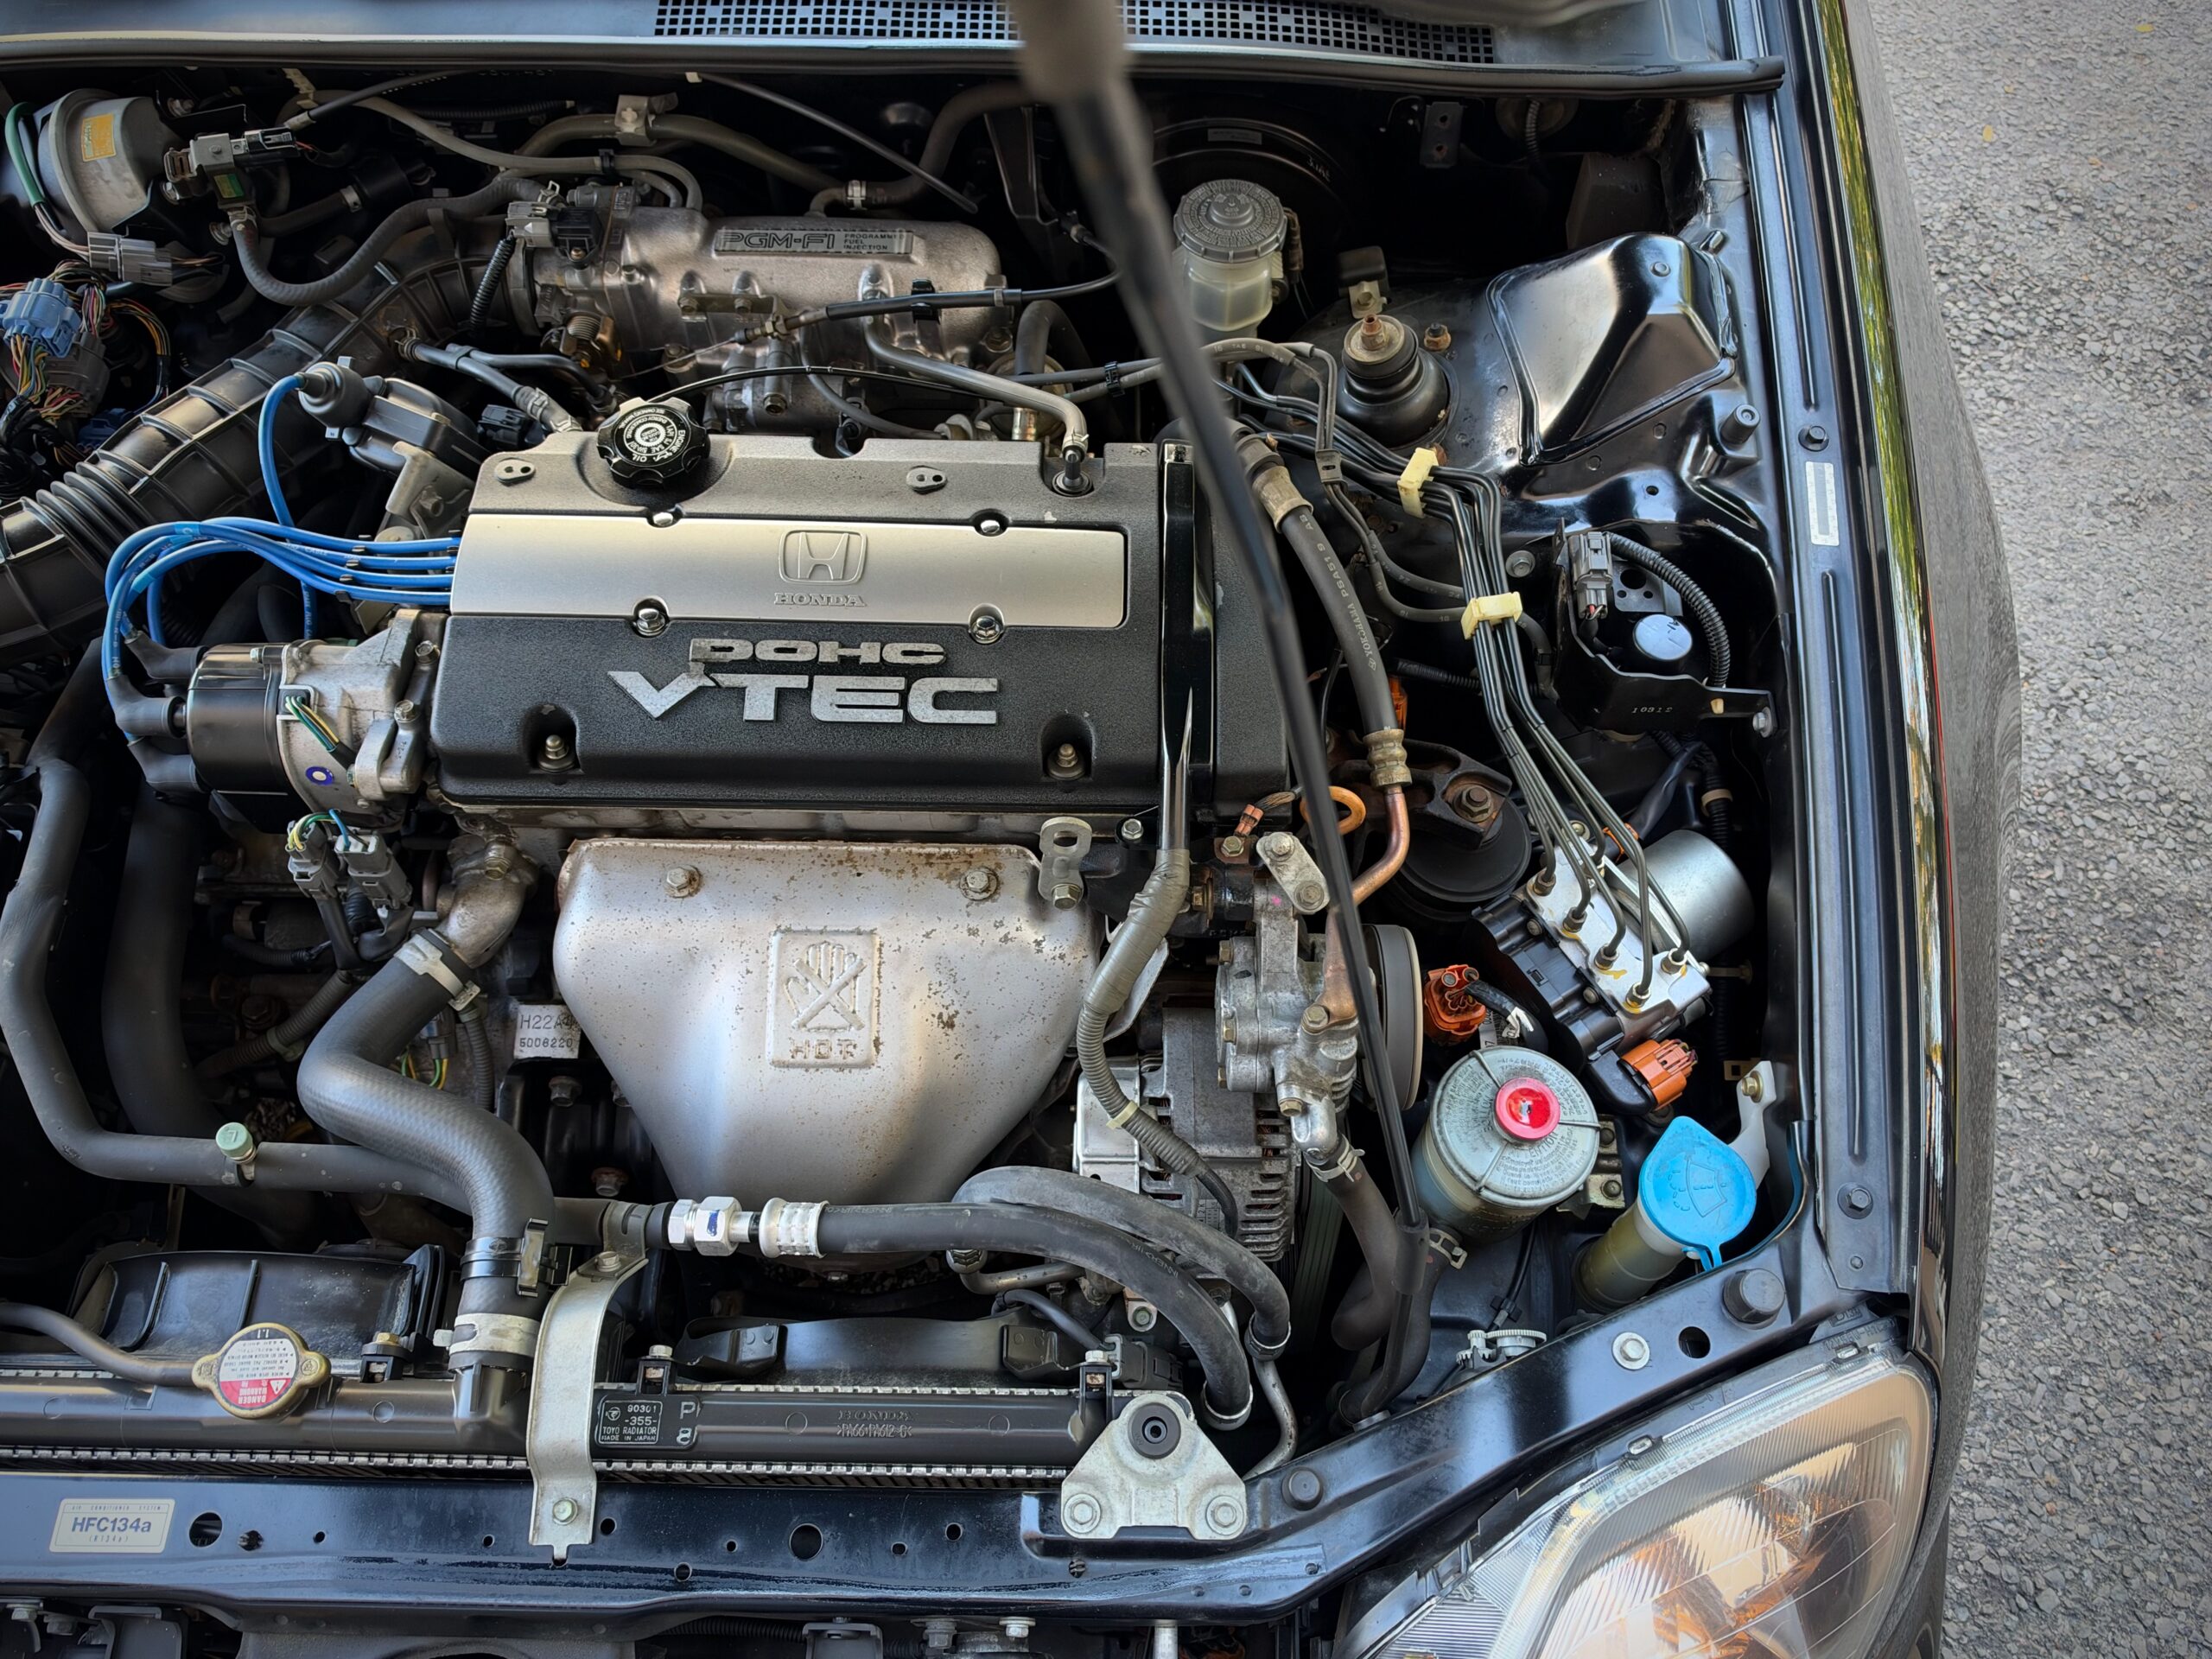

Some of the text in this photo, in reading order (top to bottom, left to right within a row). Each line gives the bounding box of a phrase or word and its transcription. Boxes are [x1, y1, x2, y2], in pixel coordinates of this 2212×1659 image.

[722, 232, 836, 250] PGM-FI
[671, 429, 685, 453] ENGINE
[632, 453, 647, 462] OIL
[774, 592, 868, 607] HONDA
[690, 638, 947, 664] DOHC
[607, 671, 999, 725] VTEC
[788, 1037, 858, 1059] HOT
[257, 1329, 270, 1338] 1.1
[238, 1395, 267, 1404] DANGER
[624, 1416, 658, 1426] -355-
[622, 1427, 658, 1435] RADIATOR
[71, 1516, 152, 1533] HFC134a
